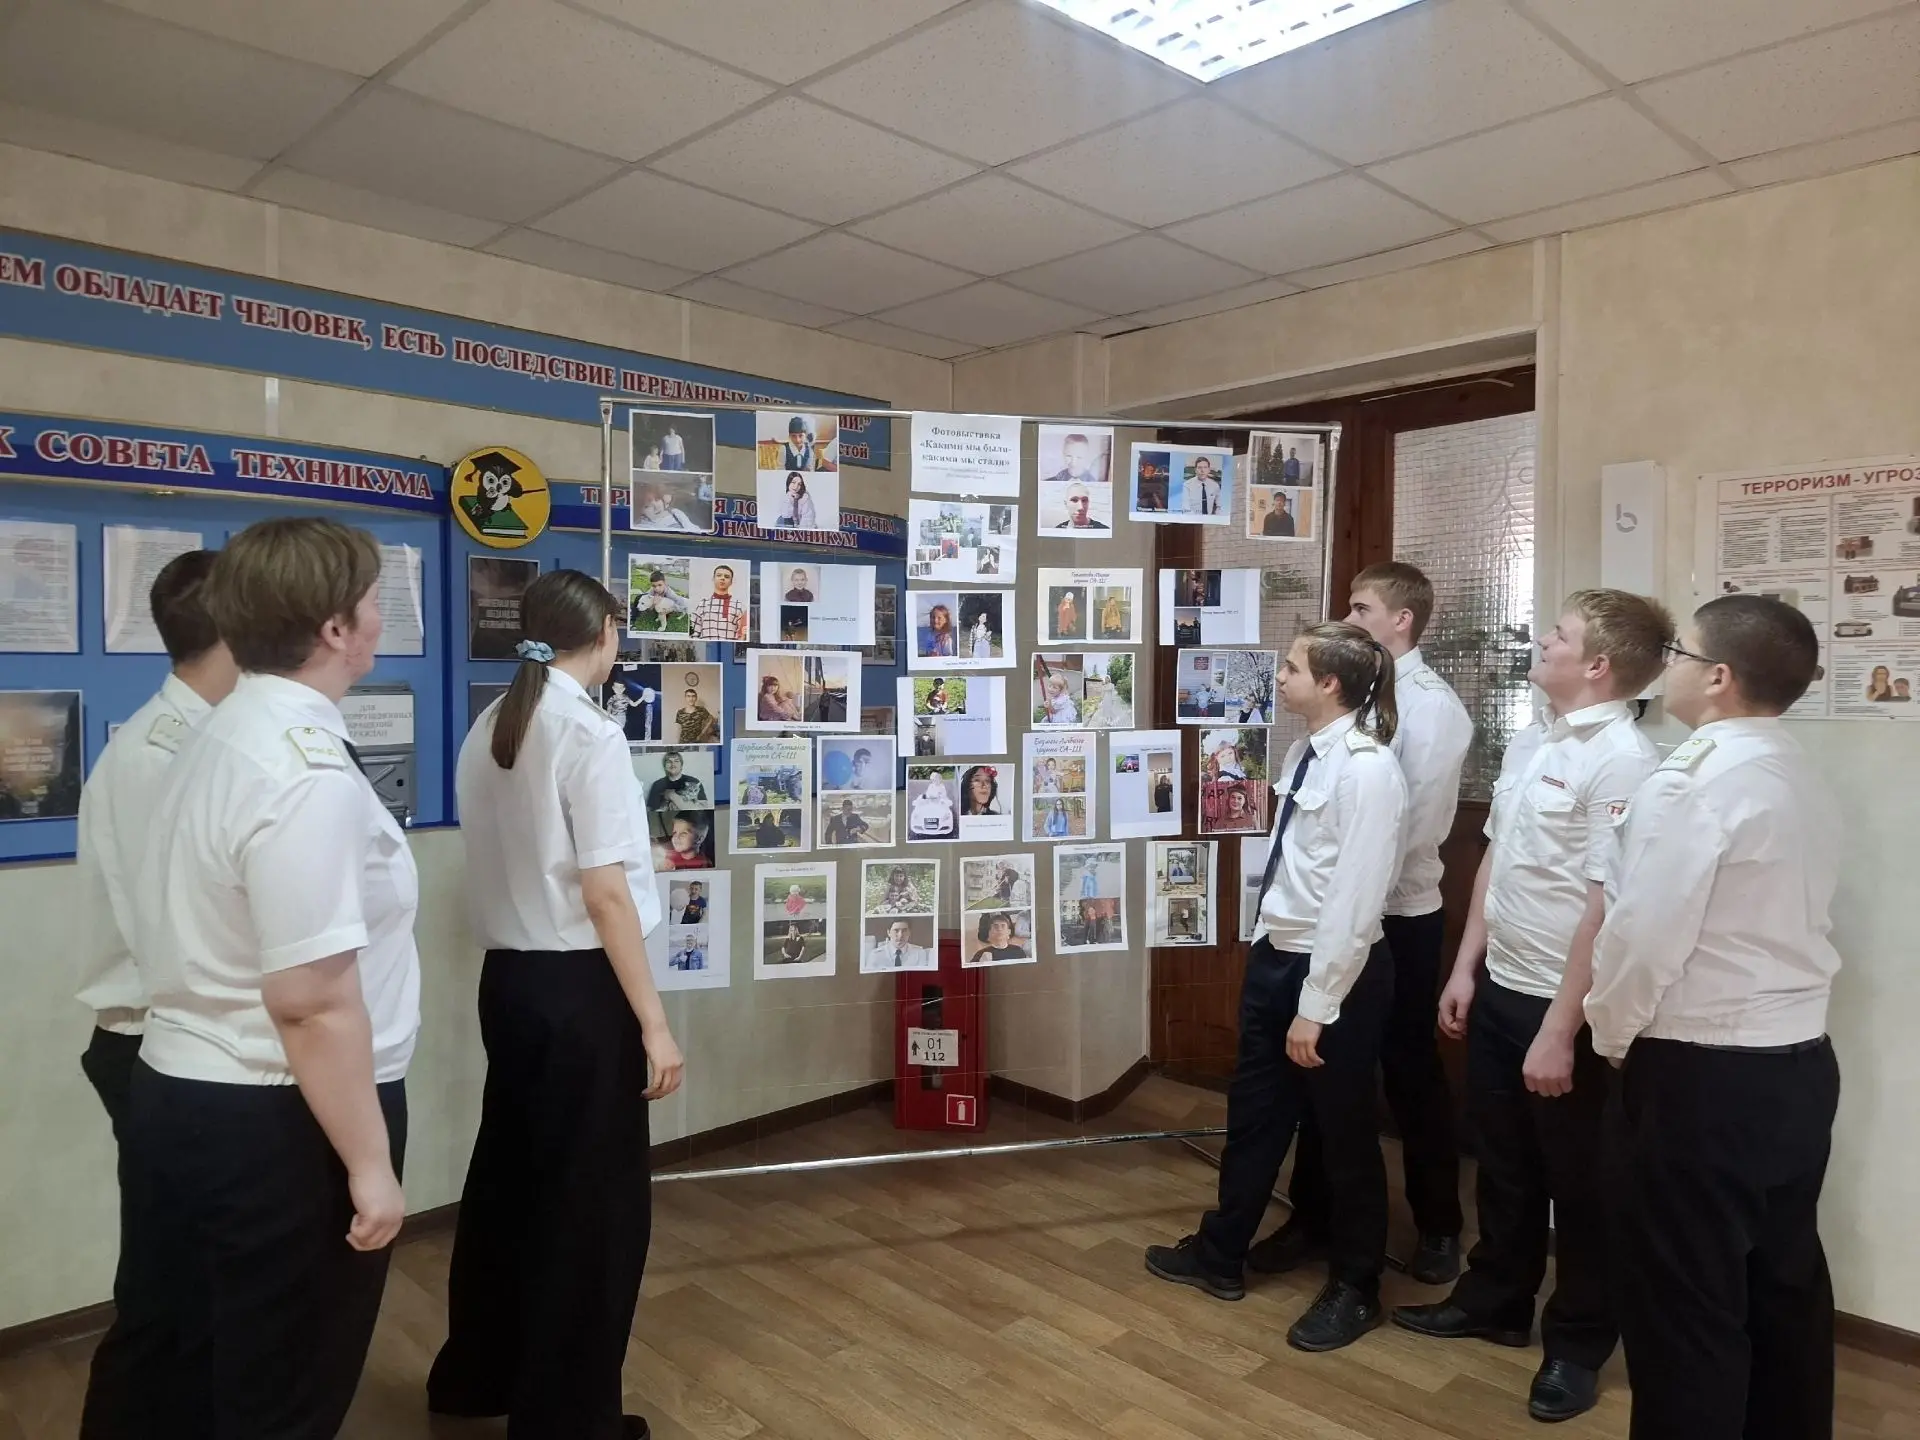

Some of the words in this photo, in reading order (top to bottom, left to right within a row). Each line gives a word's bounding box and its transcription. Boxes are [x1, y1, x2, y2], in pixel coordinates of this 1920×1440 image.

[55, 264, 223, 319] ОБЛАДАЕТ
[233, 298, 371, 350] ЧЕЛОВЕК,
[382, 323, 446, 358] ЕСТЬ
[453, 336, 615, 388] ПОСЛЕДСТВИЕ
[931, 426, 1001, 440] Фотовыставка
[920, 439, 963, 451] «Какими
[36, 431, 214, 475] СОВЕТА
[233, 448, 434, 500] ТЕХНИКУМА
[922, 454, 958, 464] какими
[977, 458, 1010, 467] стали»
[1741, 473, 1852, 497] ТЕРРОРИЗМ
[774, 527, 858, 548] ТЕХНИКУМ
[927, 1037, 942, 1050] 01
[924, 1051, 945, 1061] 112
